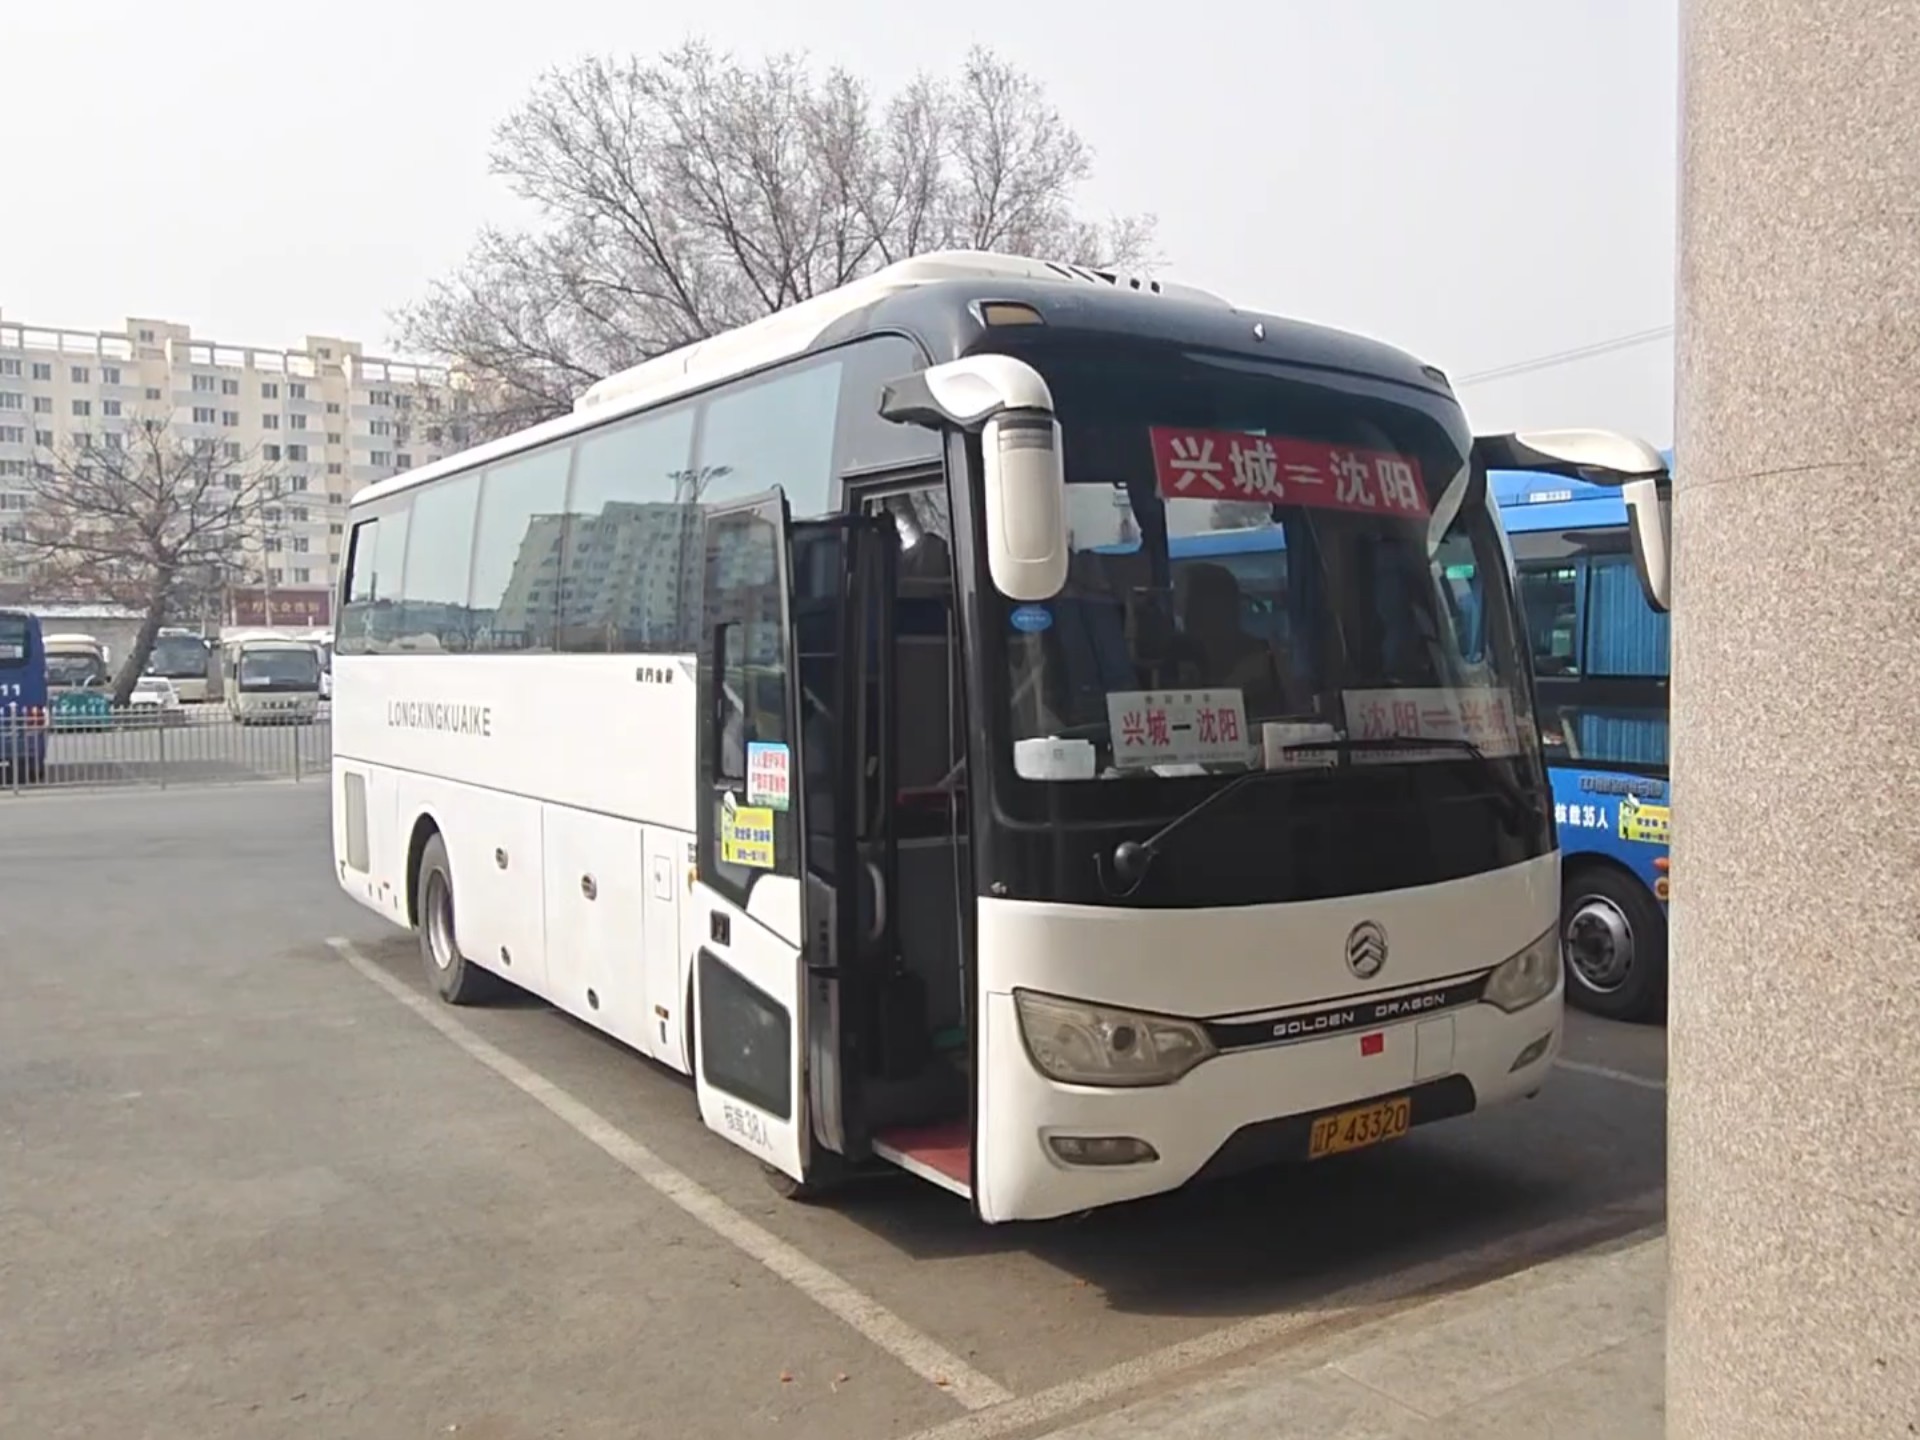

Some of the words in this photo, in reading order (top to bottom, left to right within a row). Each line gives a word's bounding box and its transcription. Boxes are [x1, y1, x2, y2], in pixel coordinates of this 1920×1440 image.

[387, 700, 491, 737] LONGXINGKUAIKE
[1273, 1012, 1355, 1036] GOLDEN
[1375, 993, 1446, 1018] DRAGON
